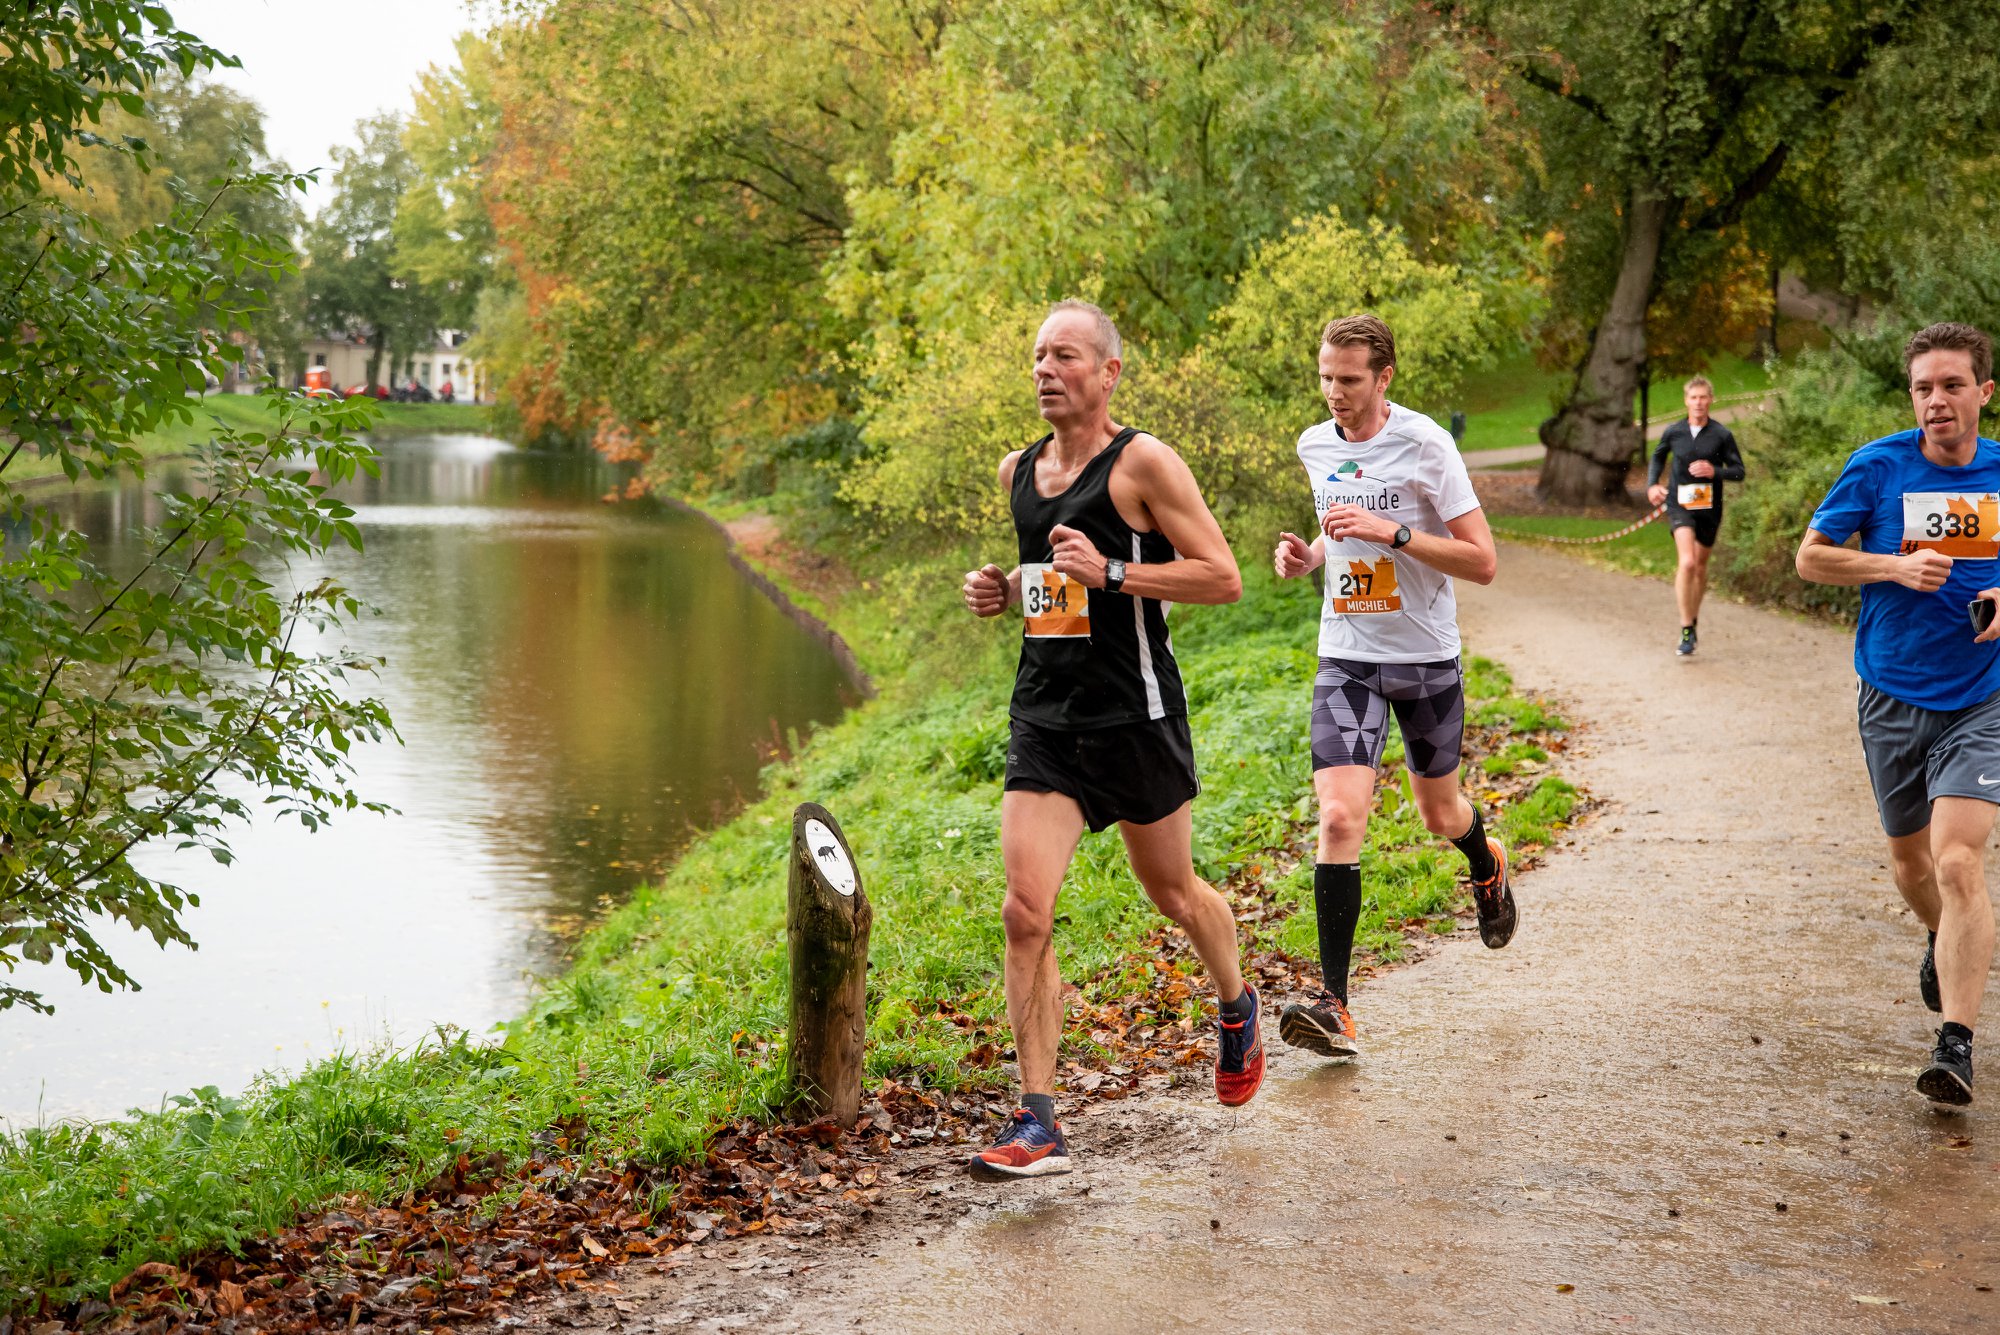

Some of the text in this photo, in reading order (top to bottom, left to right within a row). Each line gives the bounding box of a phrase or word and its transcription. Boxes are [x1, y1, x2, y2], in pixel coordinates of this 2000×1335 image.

[1926, 513, 1980, 538] 338
[1340, 573, 1373, 595] 217
[1028, 586, 1068, 613] 354
[1346, 600, 1391, 612] MICHIEL
